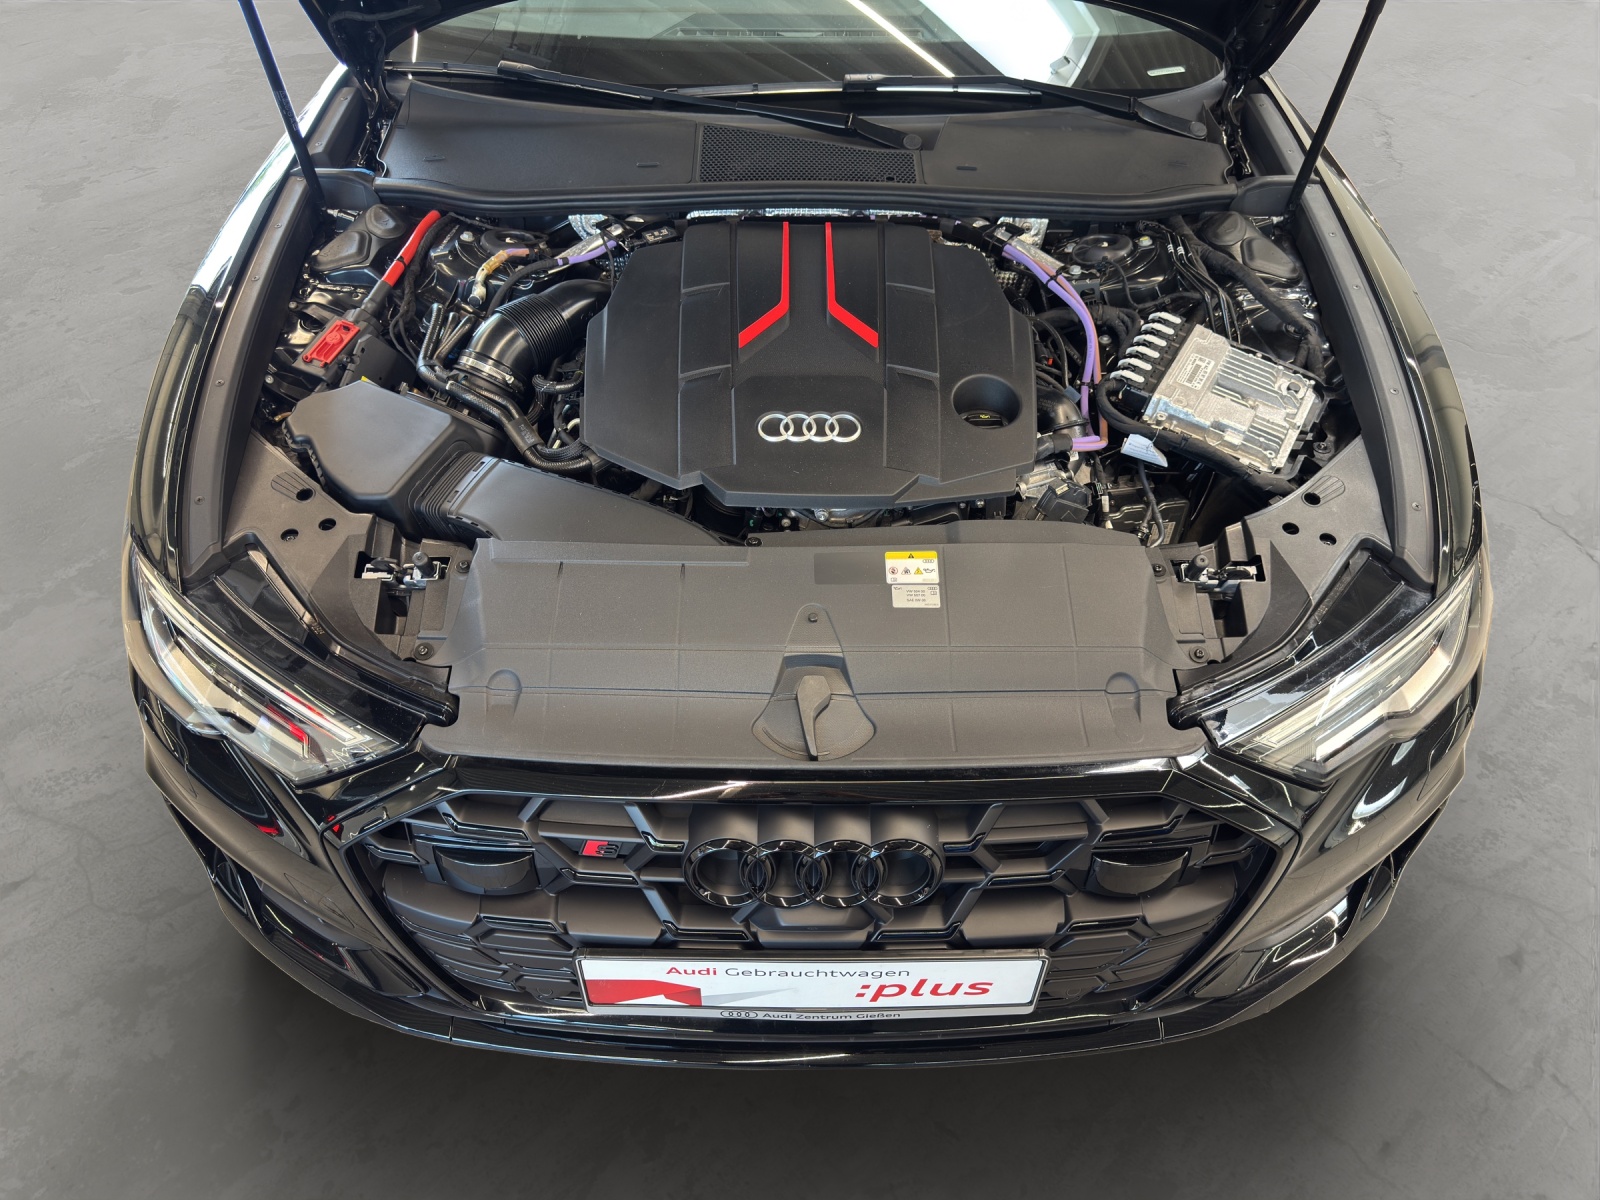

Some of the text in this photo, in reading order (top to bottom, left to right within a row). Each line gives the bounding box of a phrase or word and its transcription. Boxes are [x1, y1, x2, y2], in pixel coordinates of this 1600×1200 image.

[594, 843, 619, 856] S
[666, 966, 910, 979] Audi Gebrauchtwagen
[855, 978, 994, 1002] :plus
